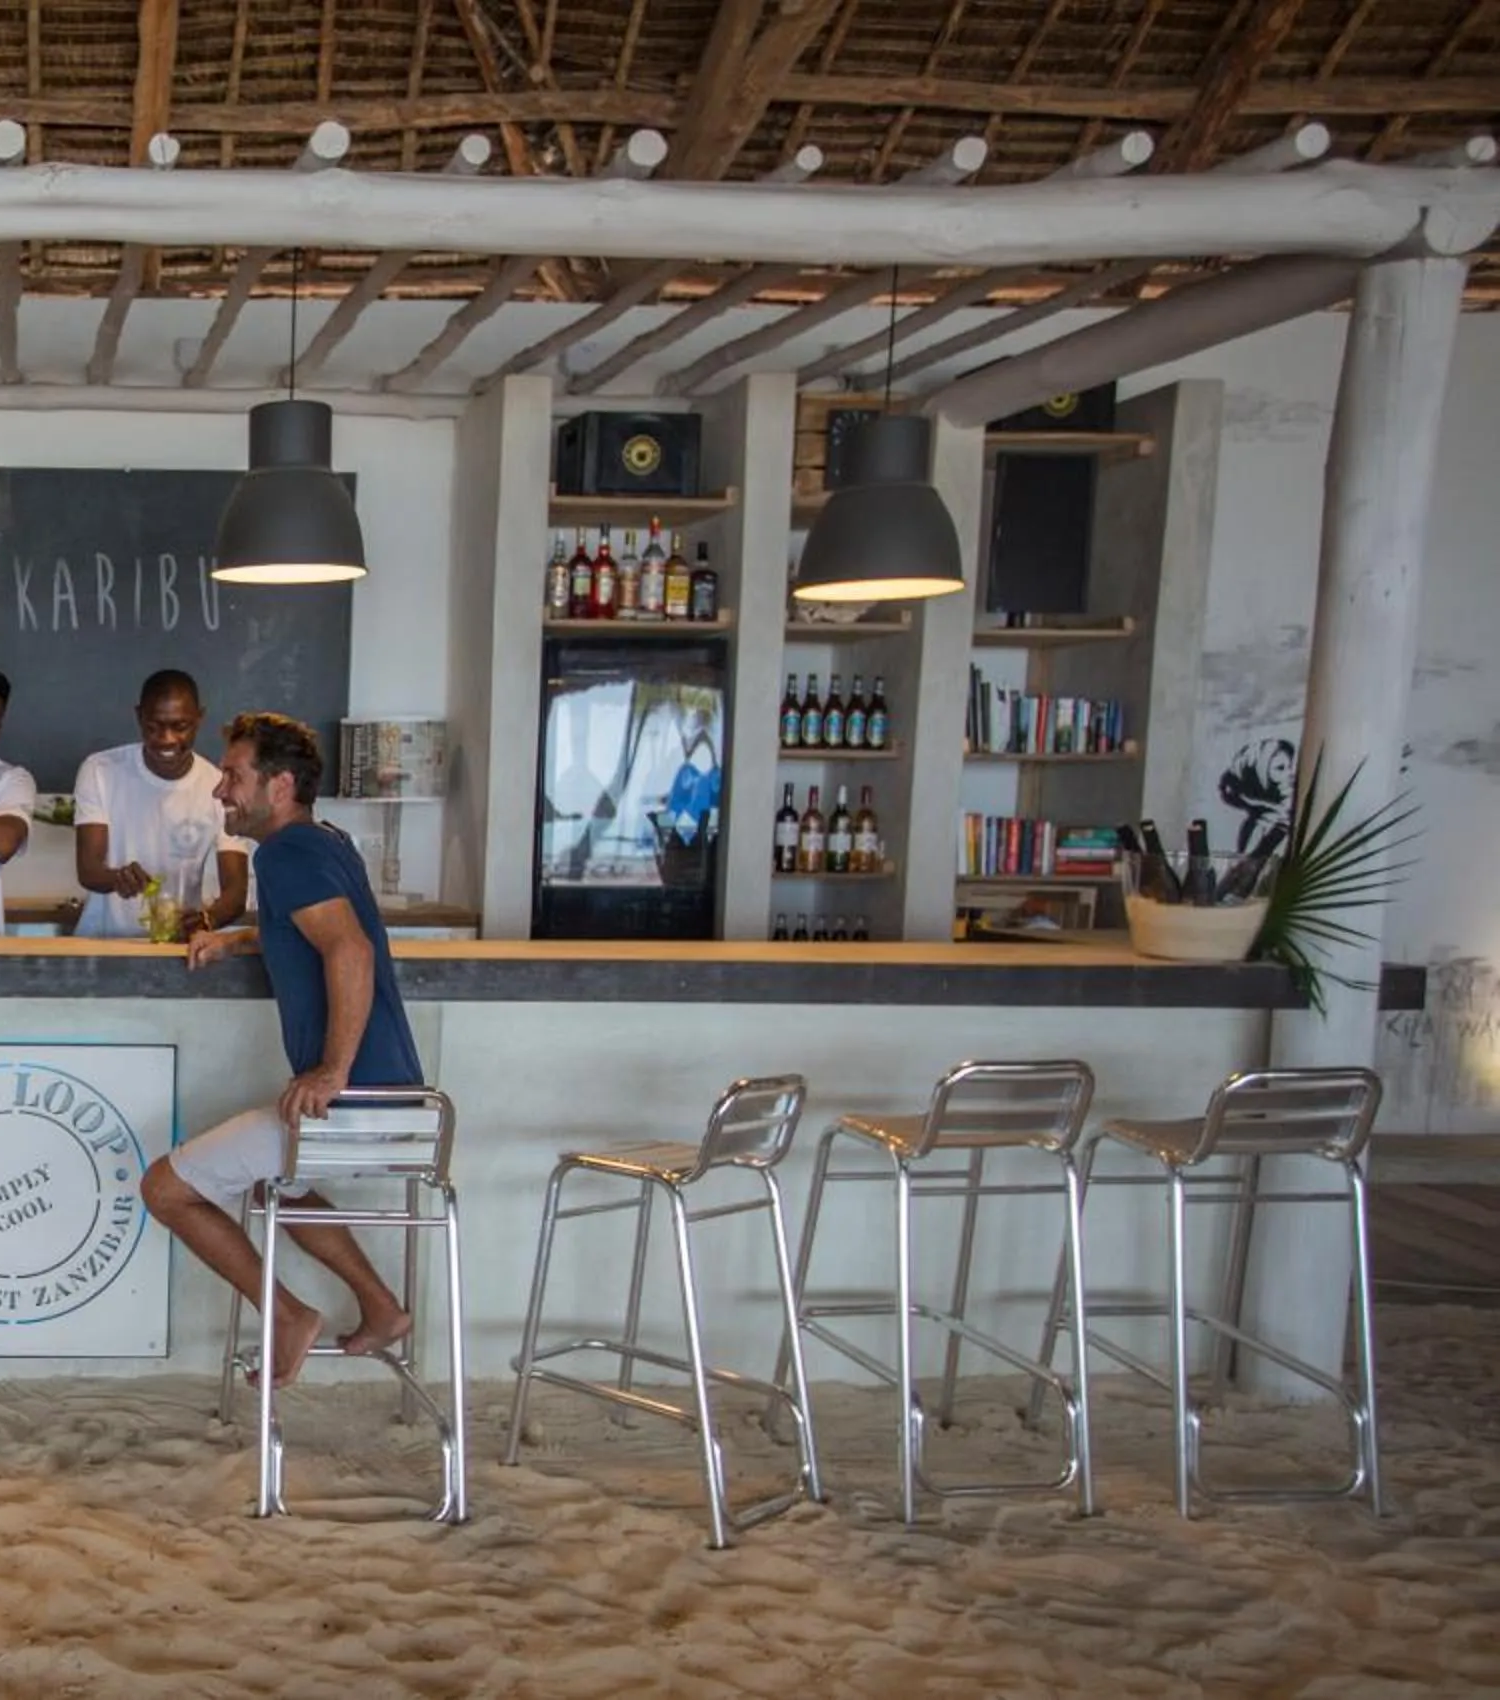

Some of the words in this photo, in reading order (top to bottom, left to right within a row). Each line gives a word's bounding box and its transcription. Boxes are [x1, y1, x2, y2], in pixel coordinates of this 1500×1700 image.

[13, 551, 220, 632] KARIBU
[12, 1071, 129, 1155] LOOP
[32, 1194, 136, 1307] ZANZIBAR
